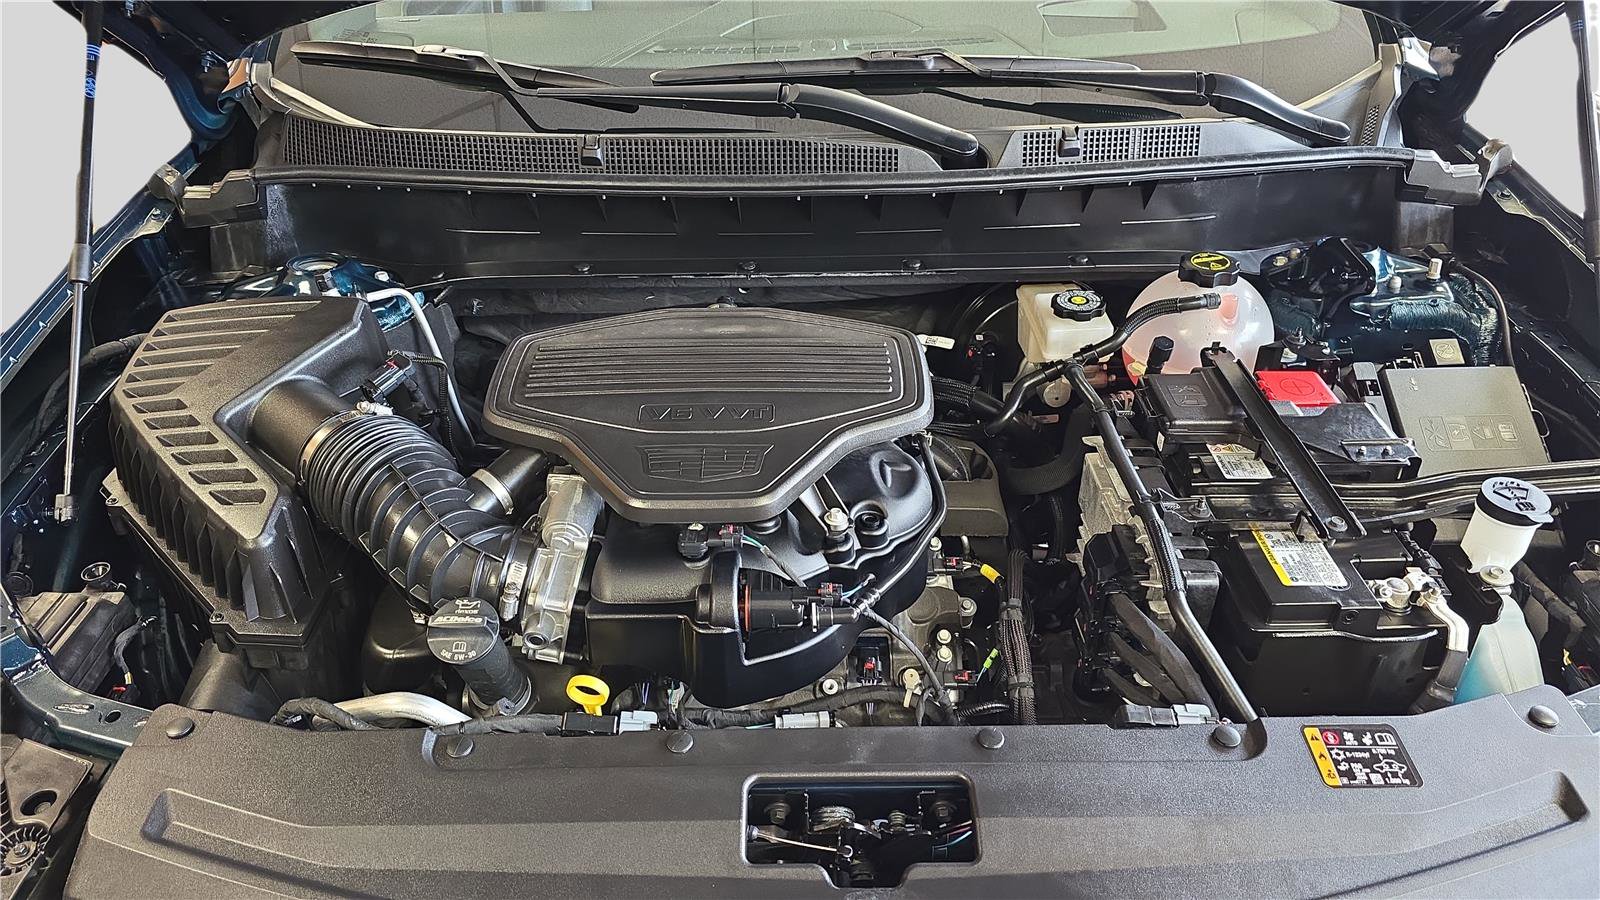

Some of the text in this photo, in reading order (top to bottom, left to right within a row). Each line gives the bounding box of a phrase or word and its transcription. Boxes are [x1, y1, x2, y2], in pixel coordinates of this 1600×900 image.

[645, 405, 770, 420] V6 VVT
[433, 616, 483, 624] ACDelco
[441, 649, 477, 660] SAE 5W-30
